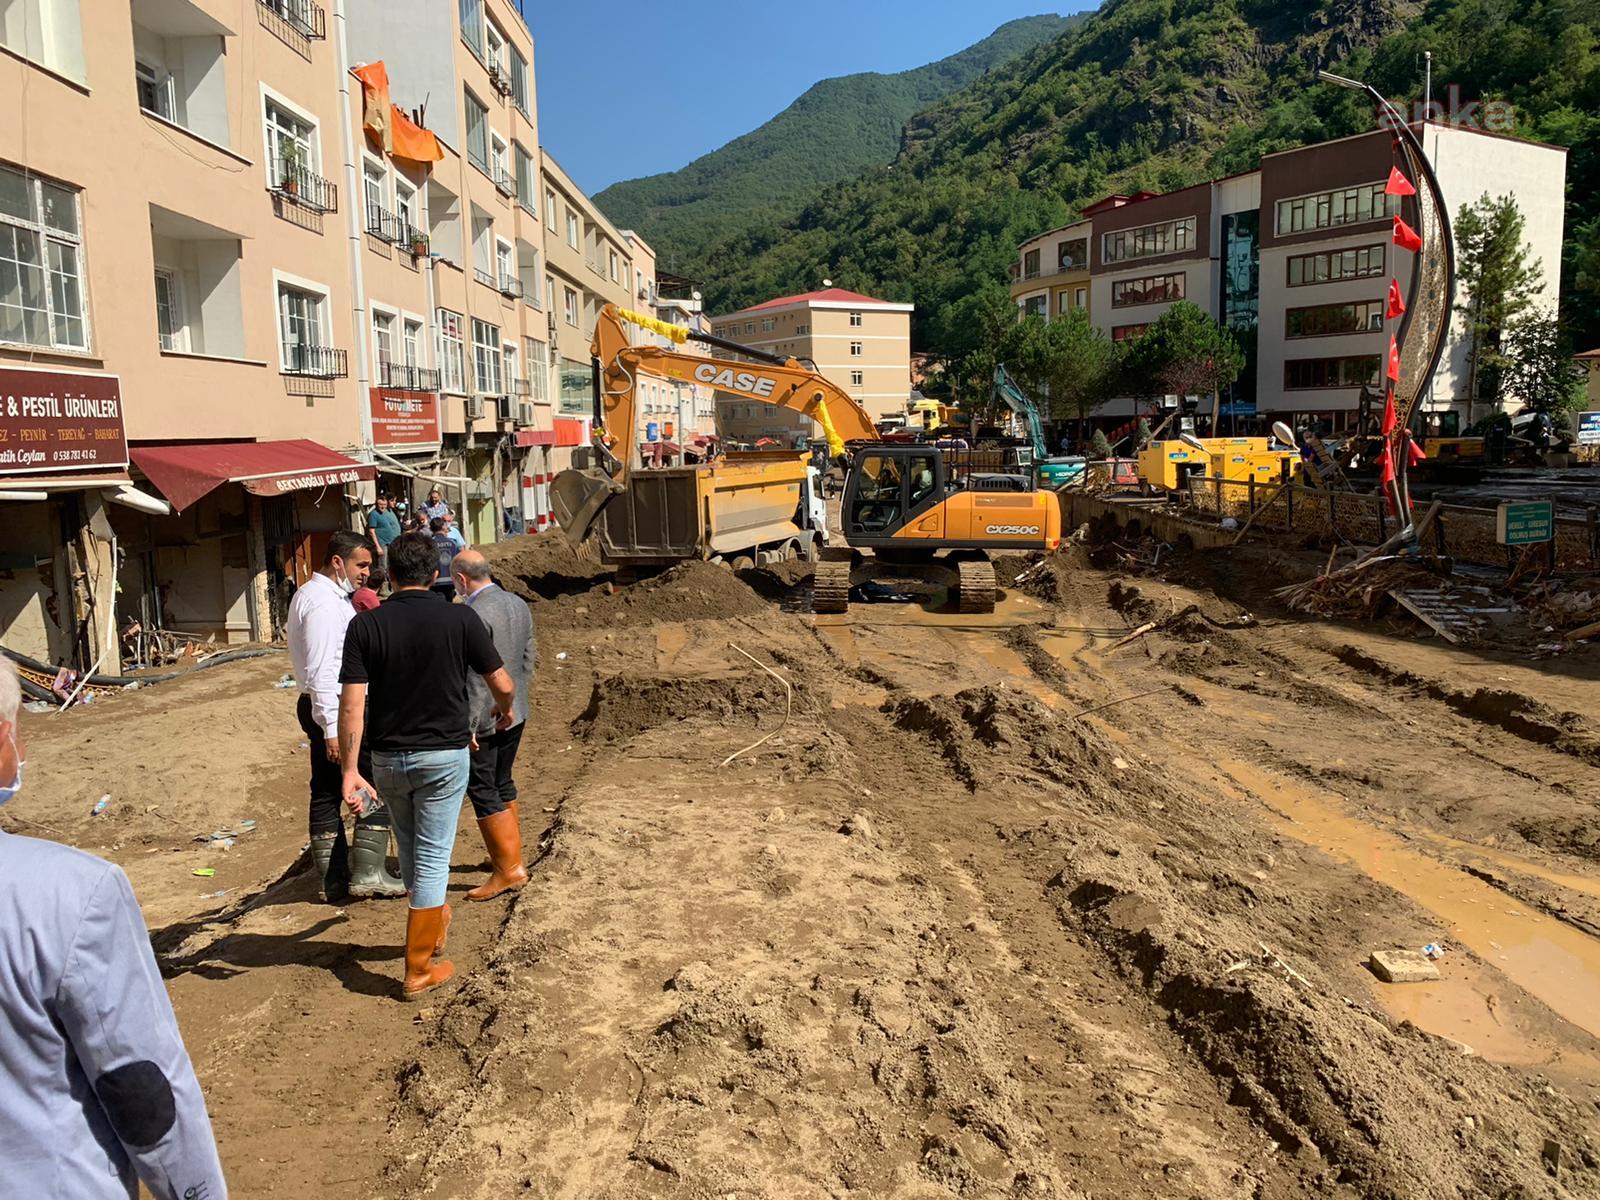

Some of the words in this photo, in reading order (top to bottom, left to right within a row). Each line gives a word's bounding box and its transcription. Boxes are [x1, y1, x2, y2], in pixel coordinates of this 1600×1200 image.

[694, 362, 776, 397] CASE
[7, 395, 19, 417] &
[22, 392, 62, 418] PESTİL
[64, 393, 119, 418] ÜRÜNLERİ
[20, 427, 47, 441] PEYNİR
[57, 427, 86, 441] TEREYAĞ
[17, 448, 46, 465] Ceylan
[53, 451, 58, 461] 0
[59, 451, 70, 461] 538
[985, 525, 1040, 535] CX250C
